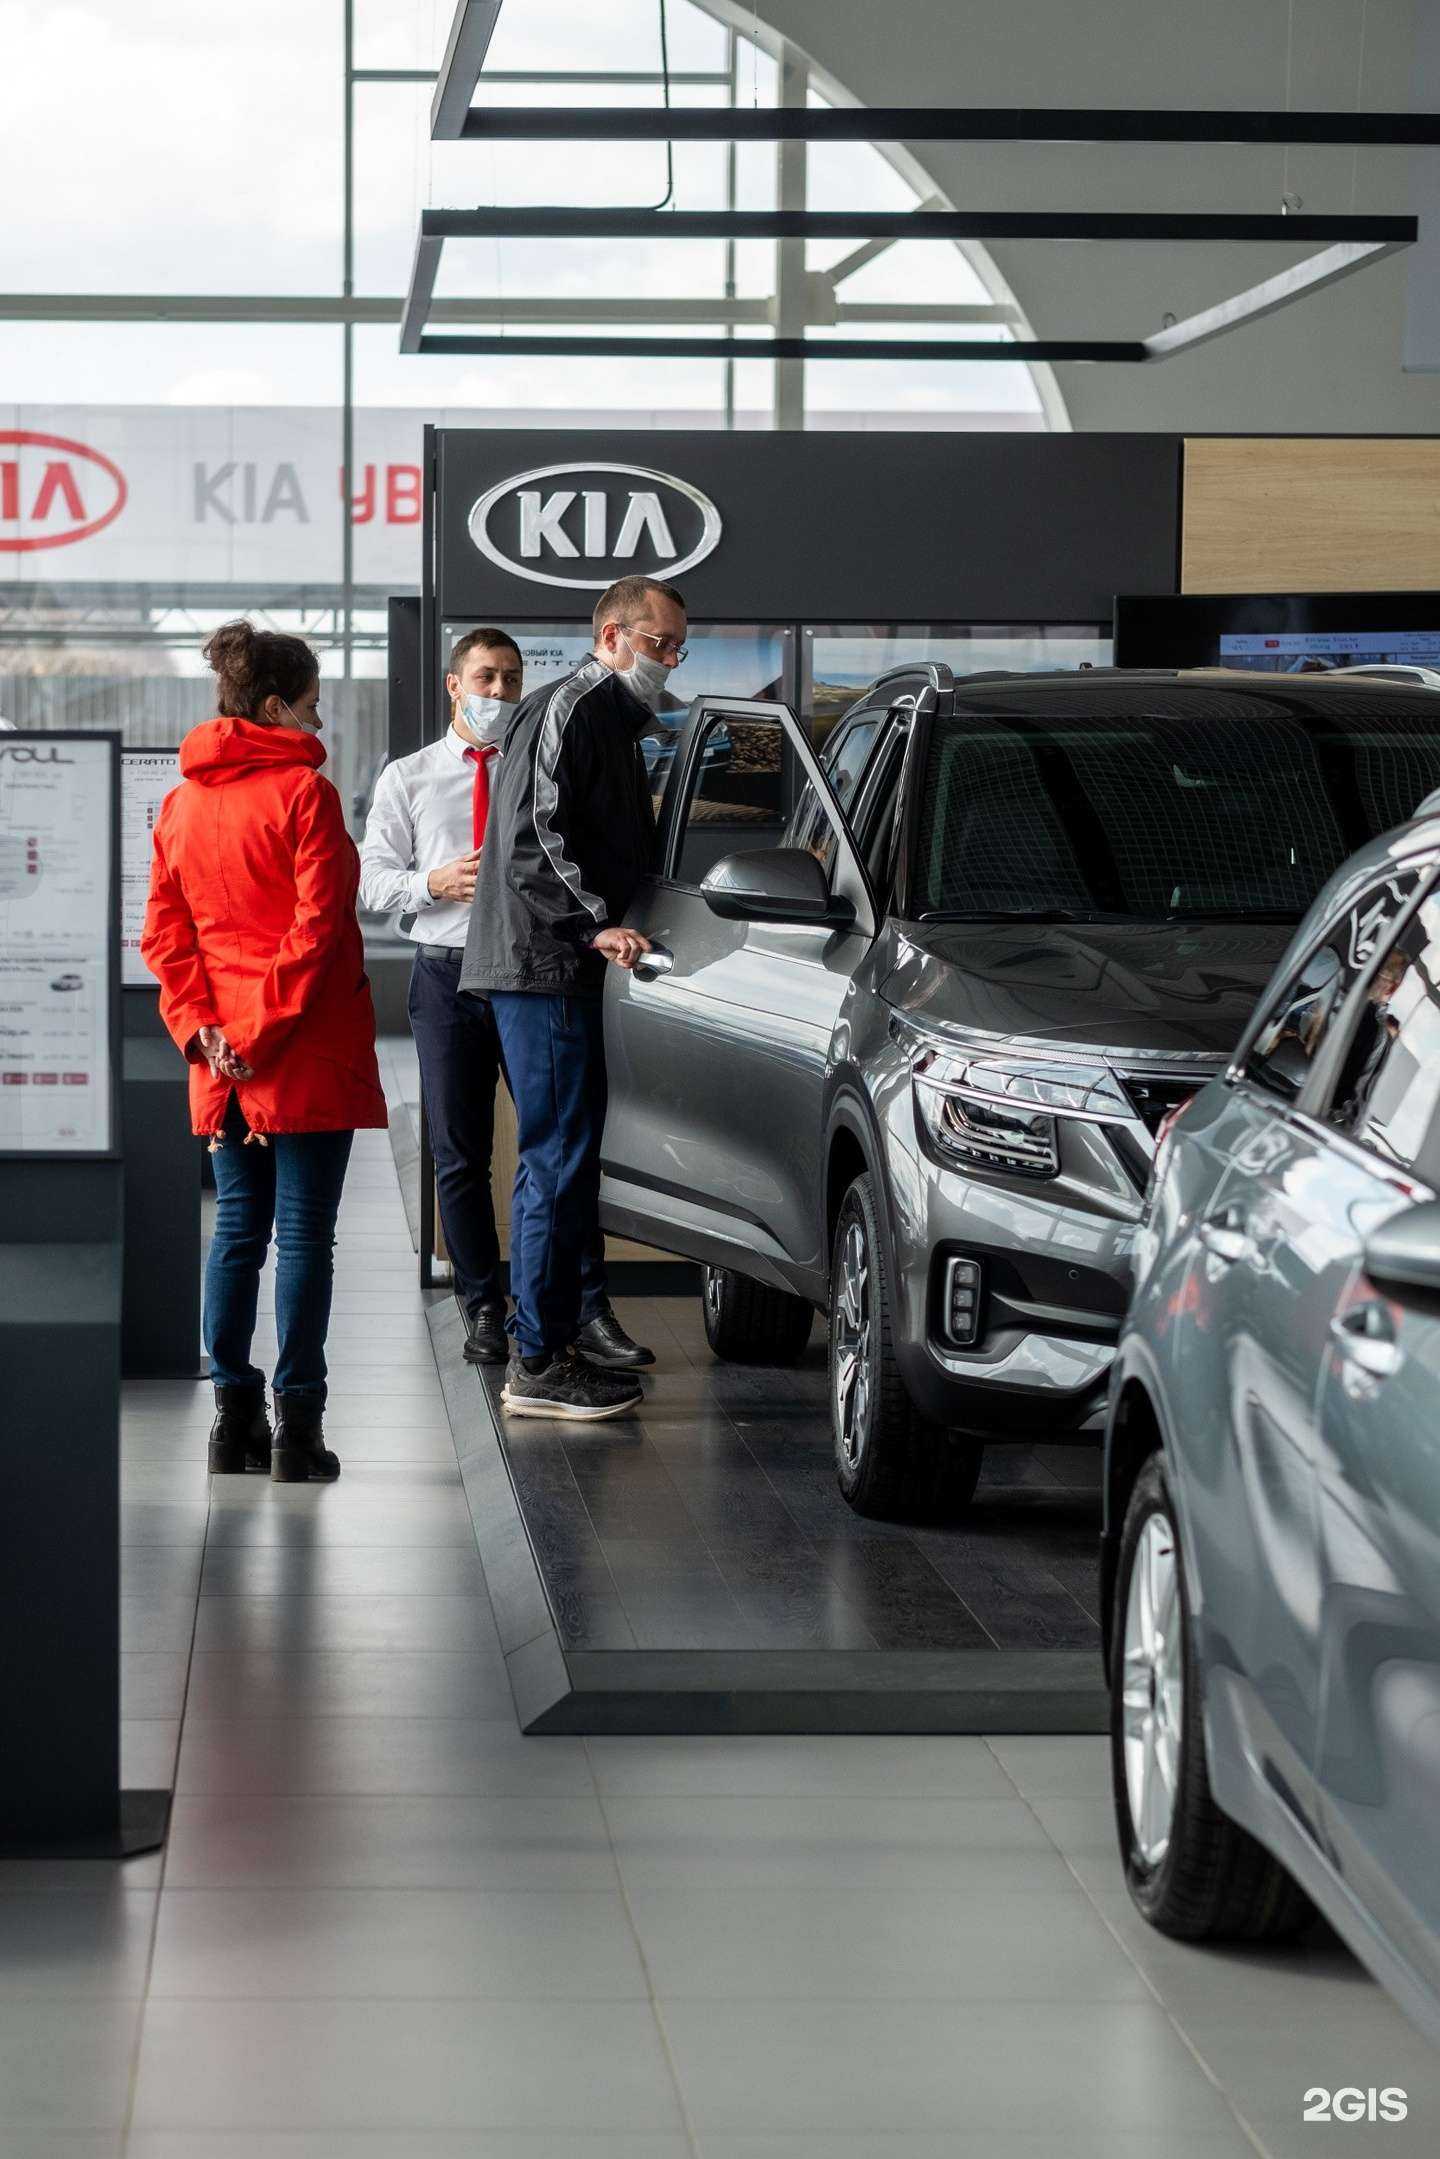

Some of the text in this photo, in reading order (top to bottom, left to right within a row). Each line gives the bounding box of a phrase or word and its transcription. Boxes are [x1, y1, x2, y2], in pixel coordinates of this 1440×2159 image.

[193, 461, 310, 524] KIA
[516, 491, 678, 559] KIA
[121, 758, 177, 767] CERATO
